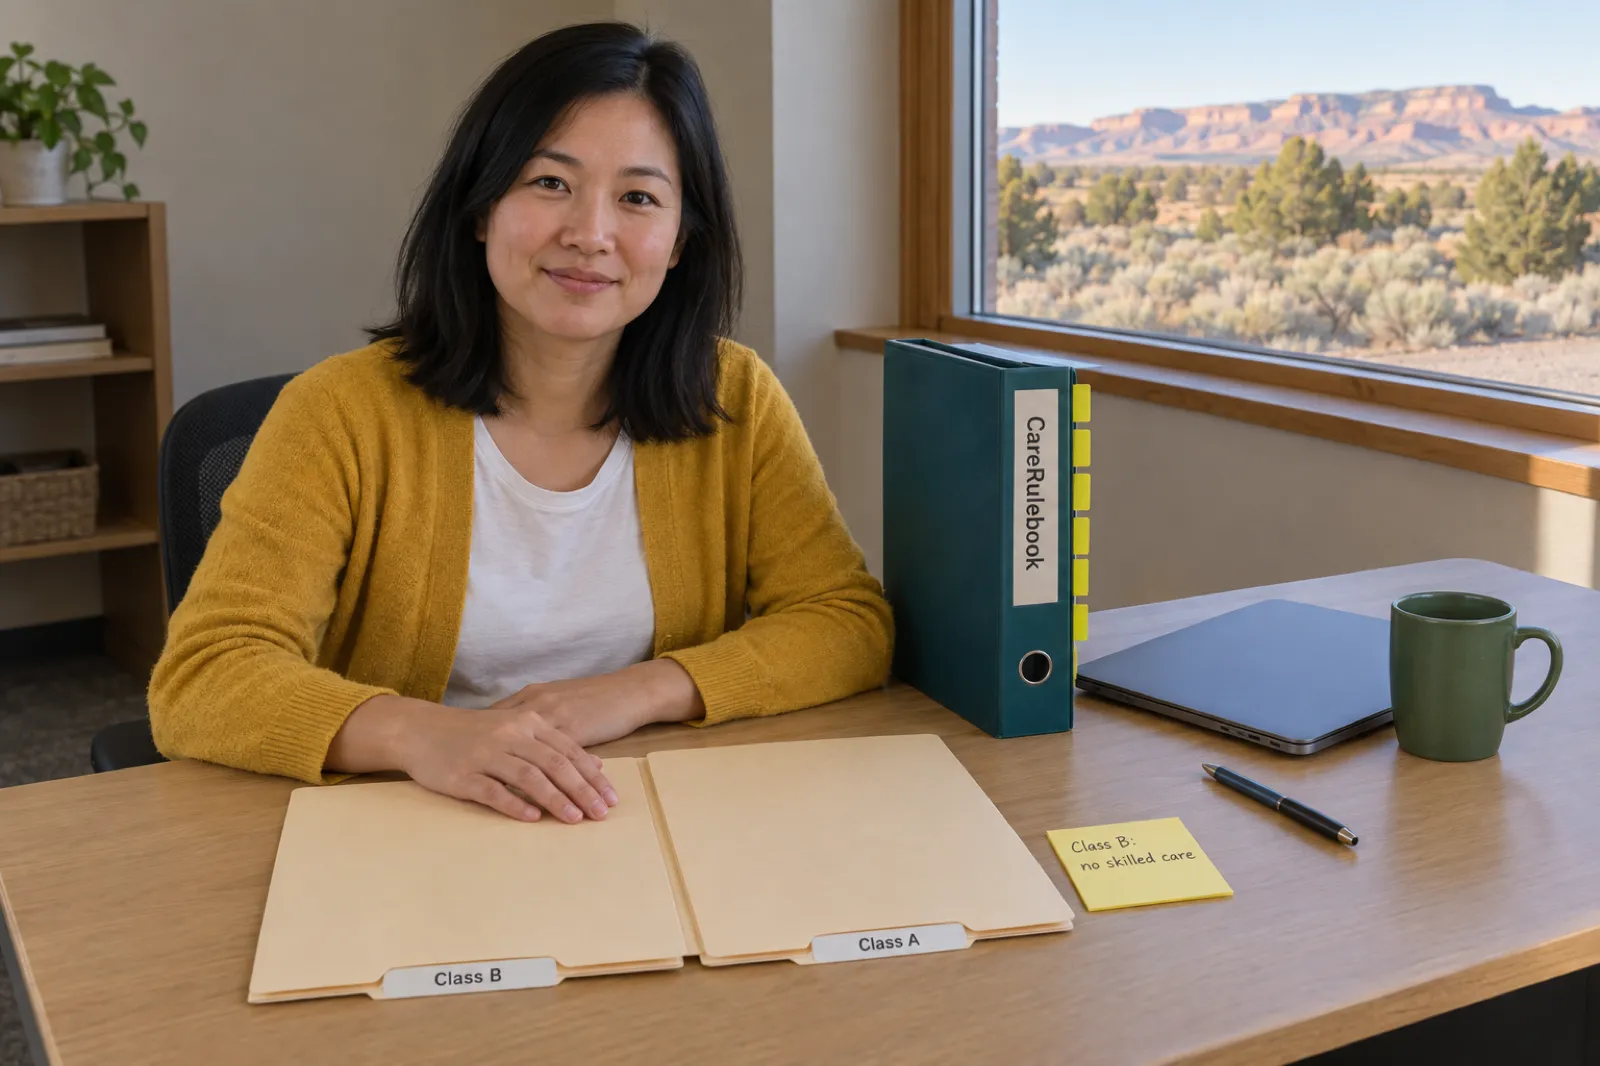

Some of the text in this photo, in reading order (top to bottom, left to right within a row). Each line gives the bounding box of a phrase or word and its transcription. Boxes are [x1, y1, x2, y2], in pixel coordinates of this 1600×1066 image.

[1025, 416, 1046, 571] CareRulebook
[1071, 835, 1136, 853] Class B:
[1080, 850, 1196, 871] no skilled care
[858, 933, 920, 952] Class A
[434, 967, 502, 986] Class B
